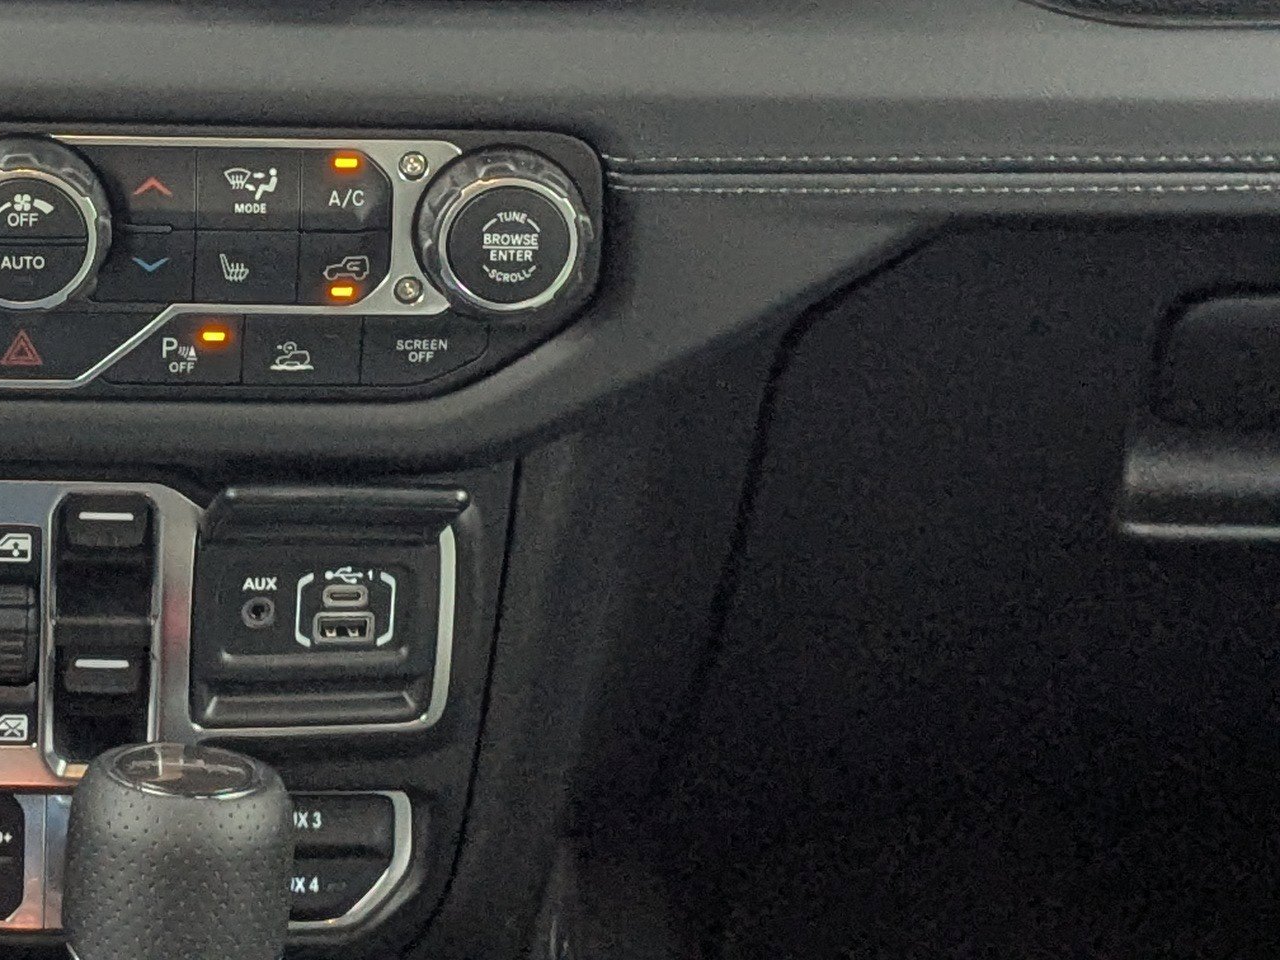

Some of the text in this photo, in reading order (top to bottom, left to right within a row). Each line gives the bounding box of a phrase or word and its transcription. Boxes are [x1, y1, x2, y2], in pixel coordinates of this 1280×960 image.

[328, 190, 365, 208] A/C
[234, 202, 267, 214] MODE
[7, 213, 38, 228] OFF
[496, 211, 528, 224] TUNE
[483, 233, 539, 246] BROWSE
[489, 249, 533, 262] ENTER
[0, 256, 46, 270] AUTO
[488, 268, 532, 283] SCROLL
[396, 339, 448, 352] SCREEN
[408, 351, 435, 363] OFF
[168, 362, 195, 373] OFF
[242, 577, 278, 591] AUX
[312, 811, 322, 829] 3
[309, 875, 320, 894] 4
